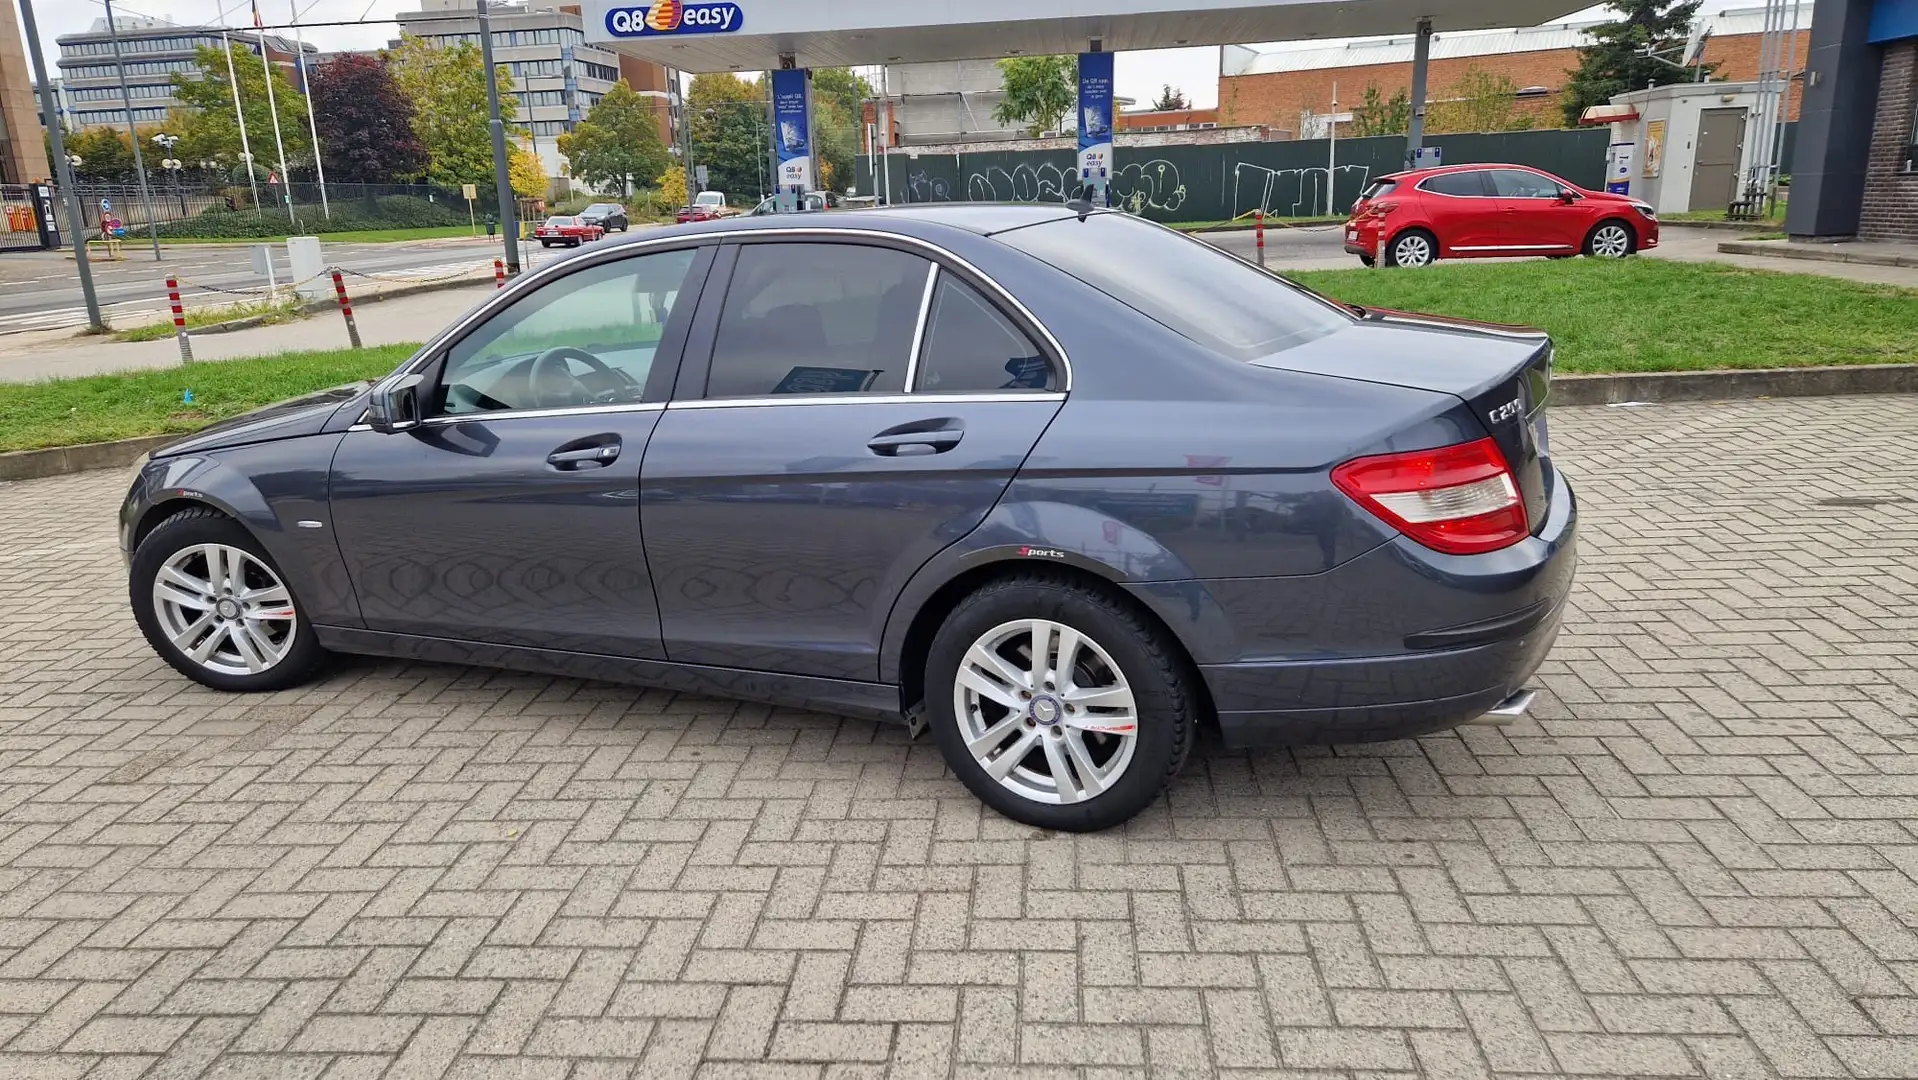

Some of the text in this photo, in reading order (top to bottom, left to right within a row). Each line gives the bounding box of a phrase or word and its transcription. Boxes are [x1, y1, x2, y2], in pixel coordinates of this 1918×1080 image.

[612, 6, 735, 32] Q8 easy
[1016, 546, 1064, 558] Sports
